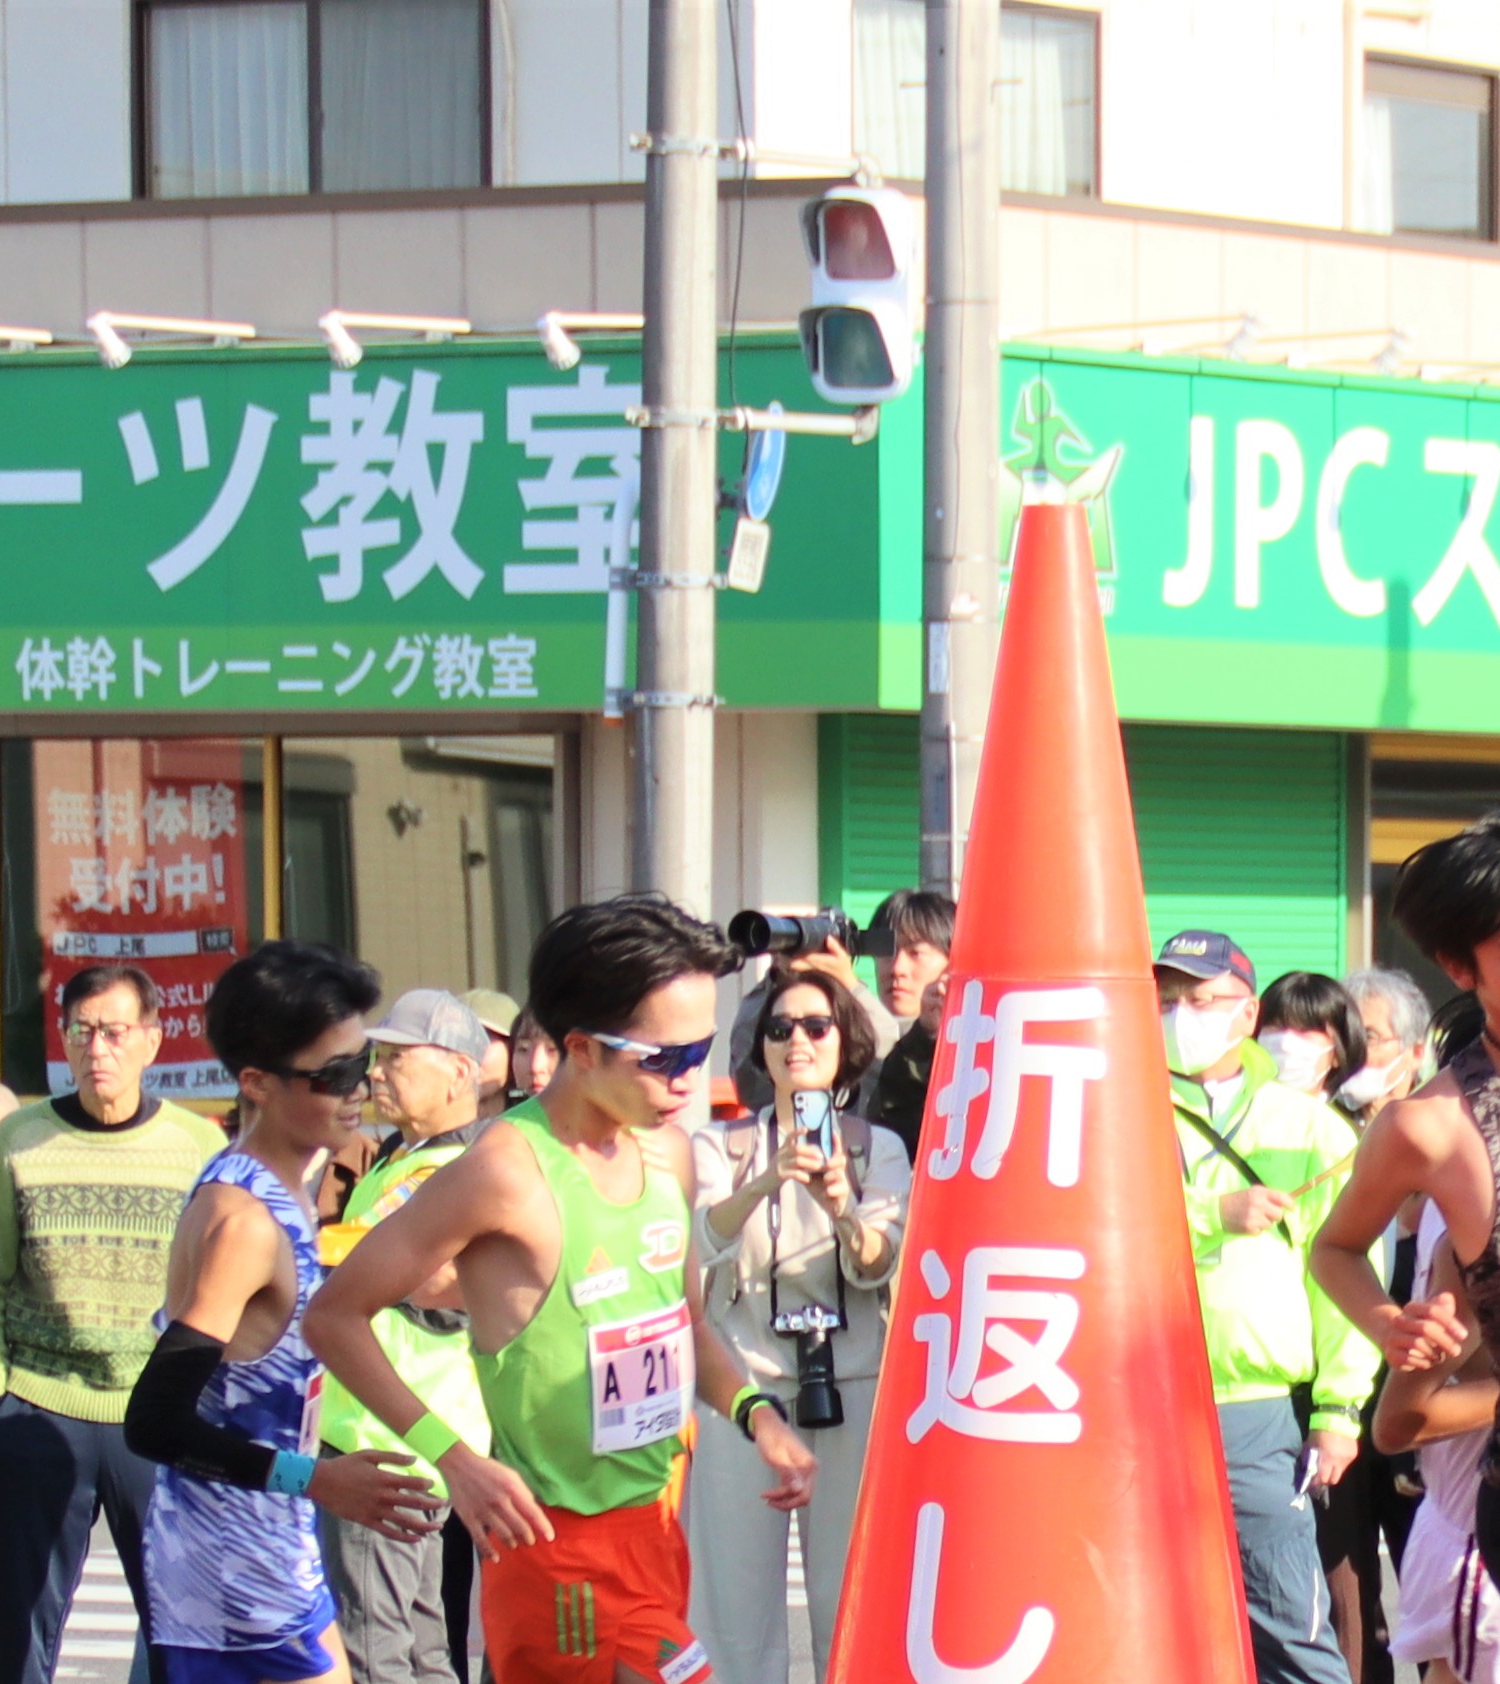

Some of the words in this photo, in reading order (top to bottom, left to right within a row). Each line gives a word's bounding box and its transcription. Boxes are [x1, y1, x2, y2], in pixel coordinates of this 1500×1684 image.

[15, 633, 540, 702] 体幹トレーニング教室
[47, 781, 238, 848] 無料体験
[56, 931, 98, 955] JPC
[114, 936, 146, 956] 上尾
[603, 1361, 622, 1404] A
